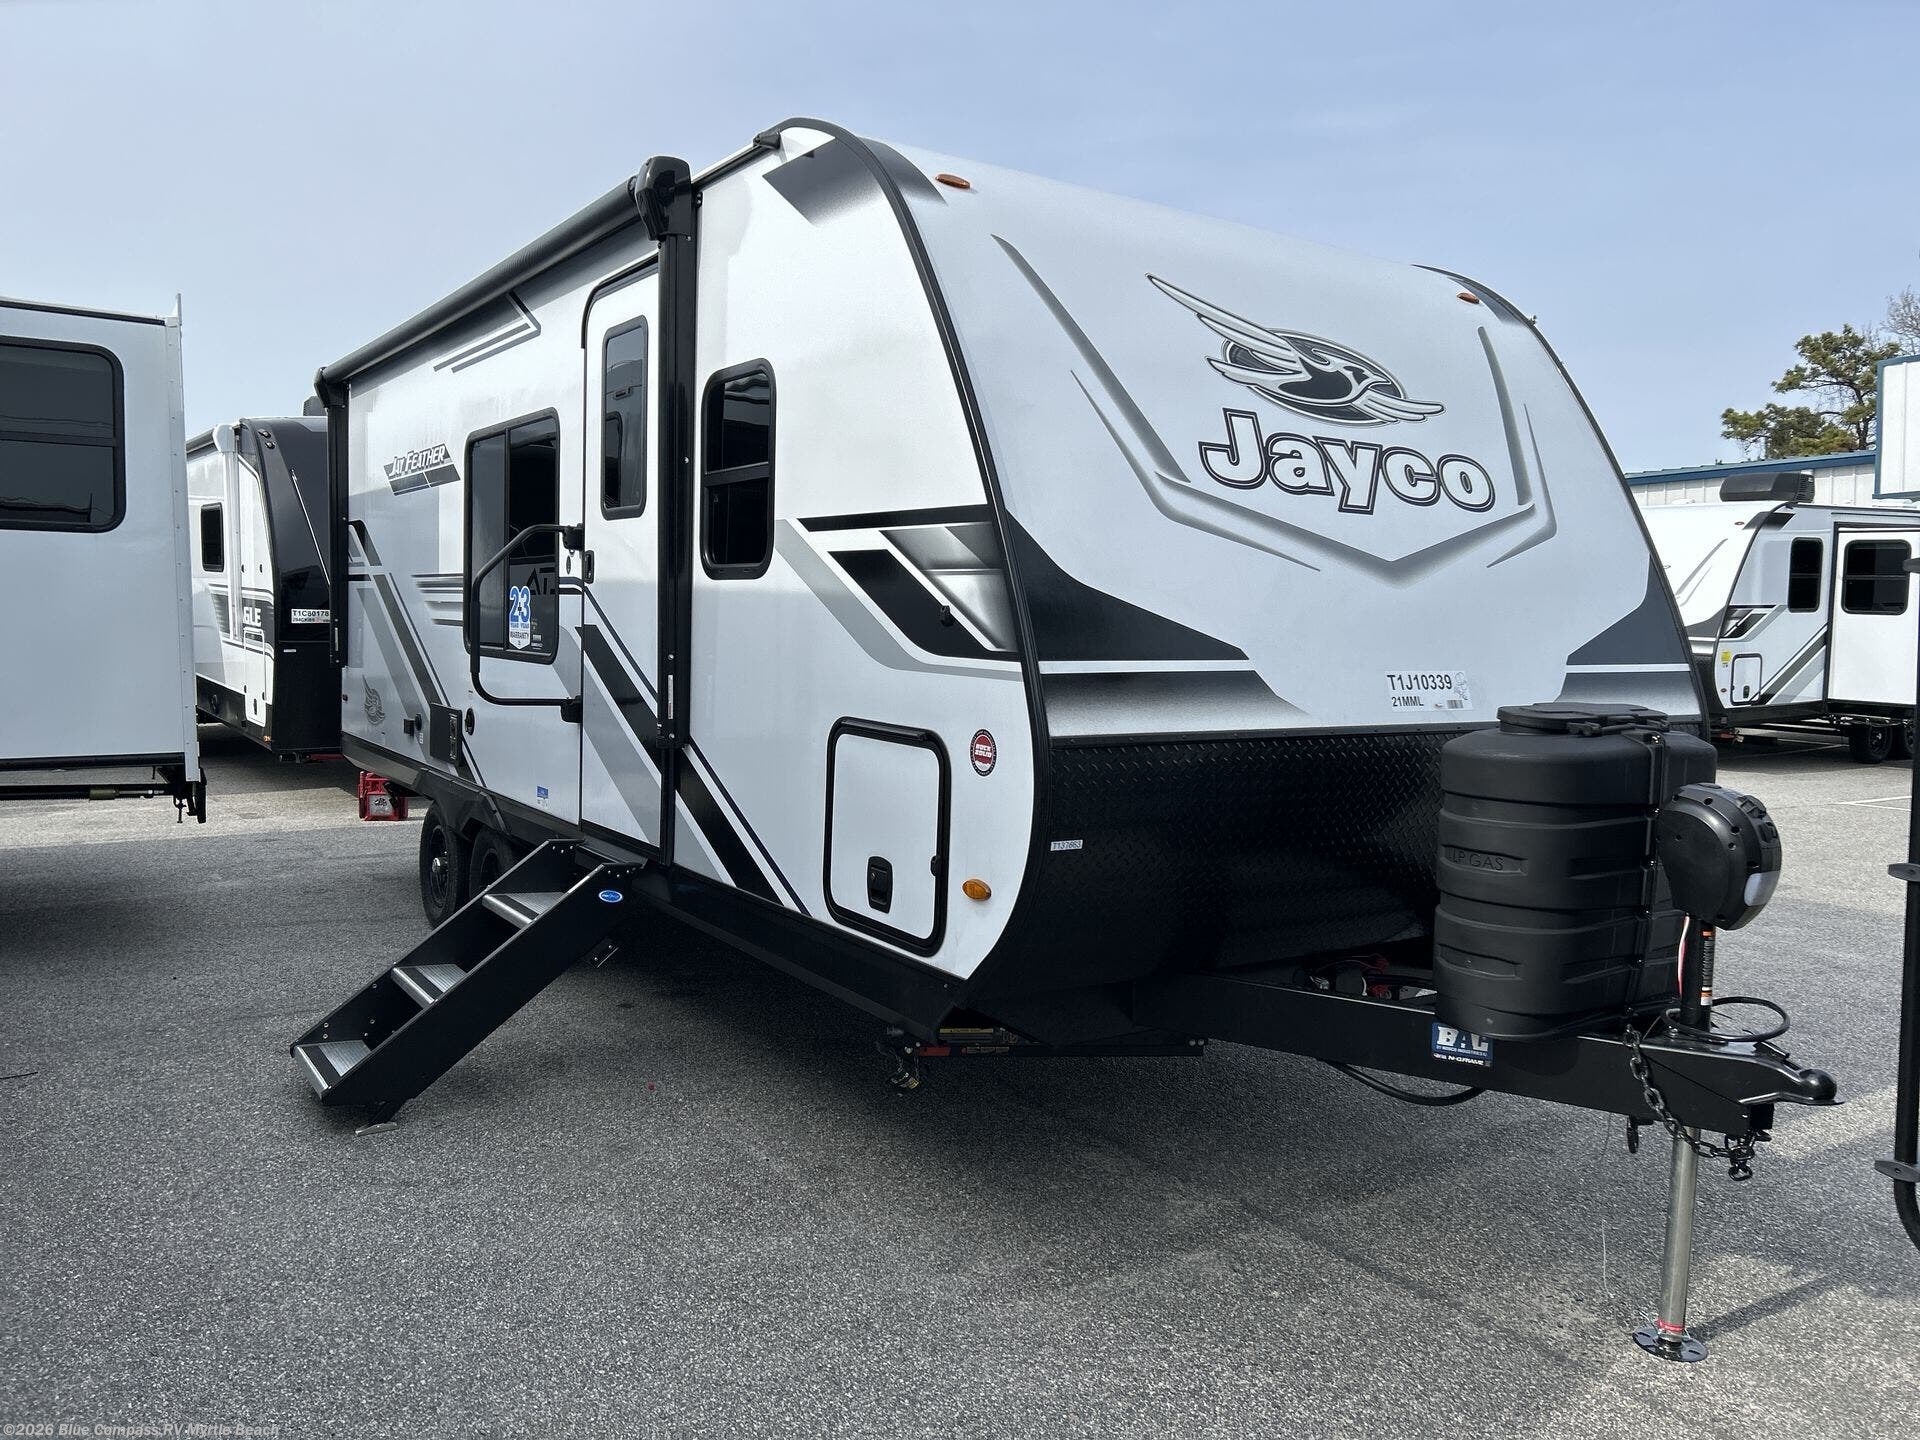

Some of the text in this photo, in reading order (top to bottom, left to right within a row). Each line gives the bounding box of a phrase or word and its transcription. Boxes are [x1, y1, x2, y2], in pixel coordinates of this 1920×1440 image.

[404, 443, 447, 473] FEATHER
[1198, 407, 1496, 516] Jayco
[243, 606, 262, 628] GLE
[1386, 674, 1453, 690] T1J10339
[1391, 696, 1424, 707] 21MML
[1469, 853, 1504, 871] GAS
